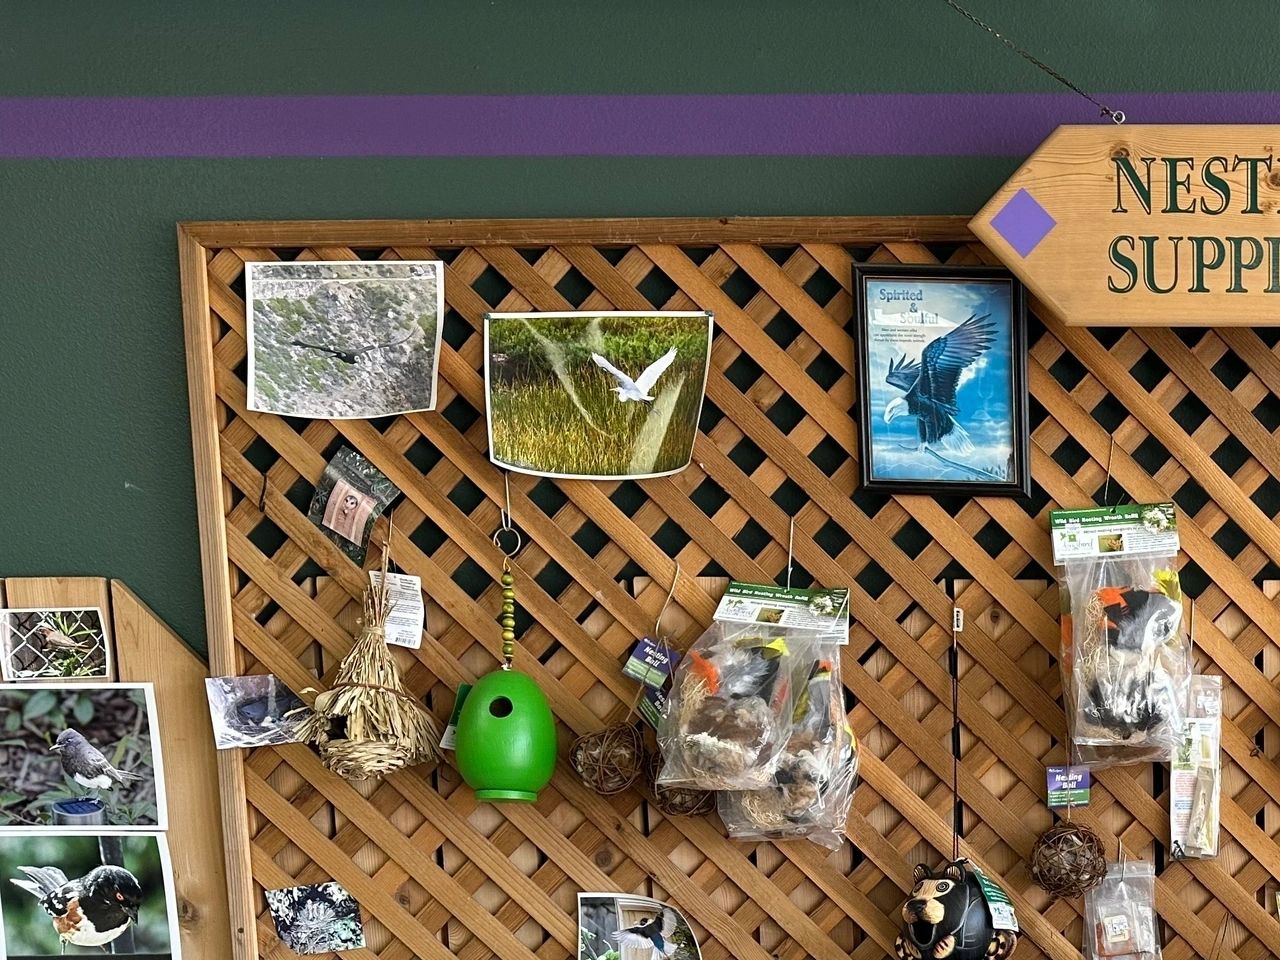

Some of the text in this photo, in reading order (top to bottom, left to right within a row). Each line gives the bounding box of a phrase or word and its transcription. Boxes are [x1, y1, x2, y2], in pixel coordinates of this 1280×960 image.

[880, 288, 923, 302] Spirited
[909, 303, 918, 313] &
[900, 312, 939, 324] Soulful
[644, 646, 669, 664] Nesting
[645, 656, 660, 668] Ball
[1055, 773, 1083, 782] Nesting
[1062, 781, 1077, 789] Ball
